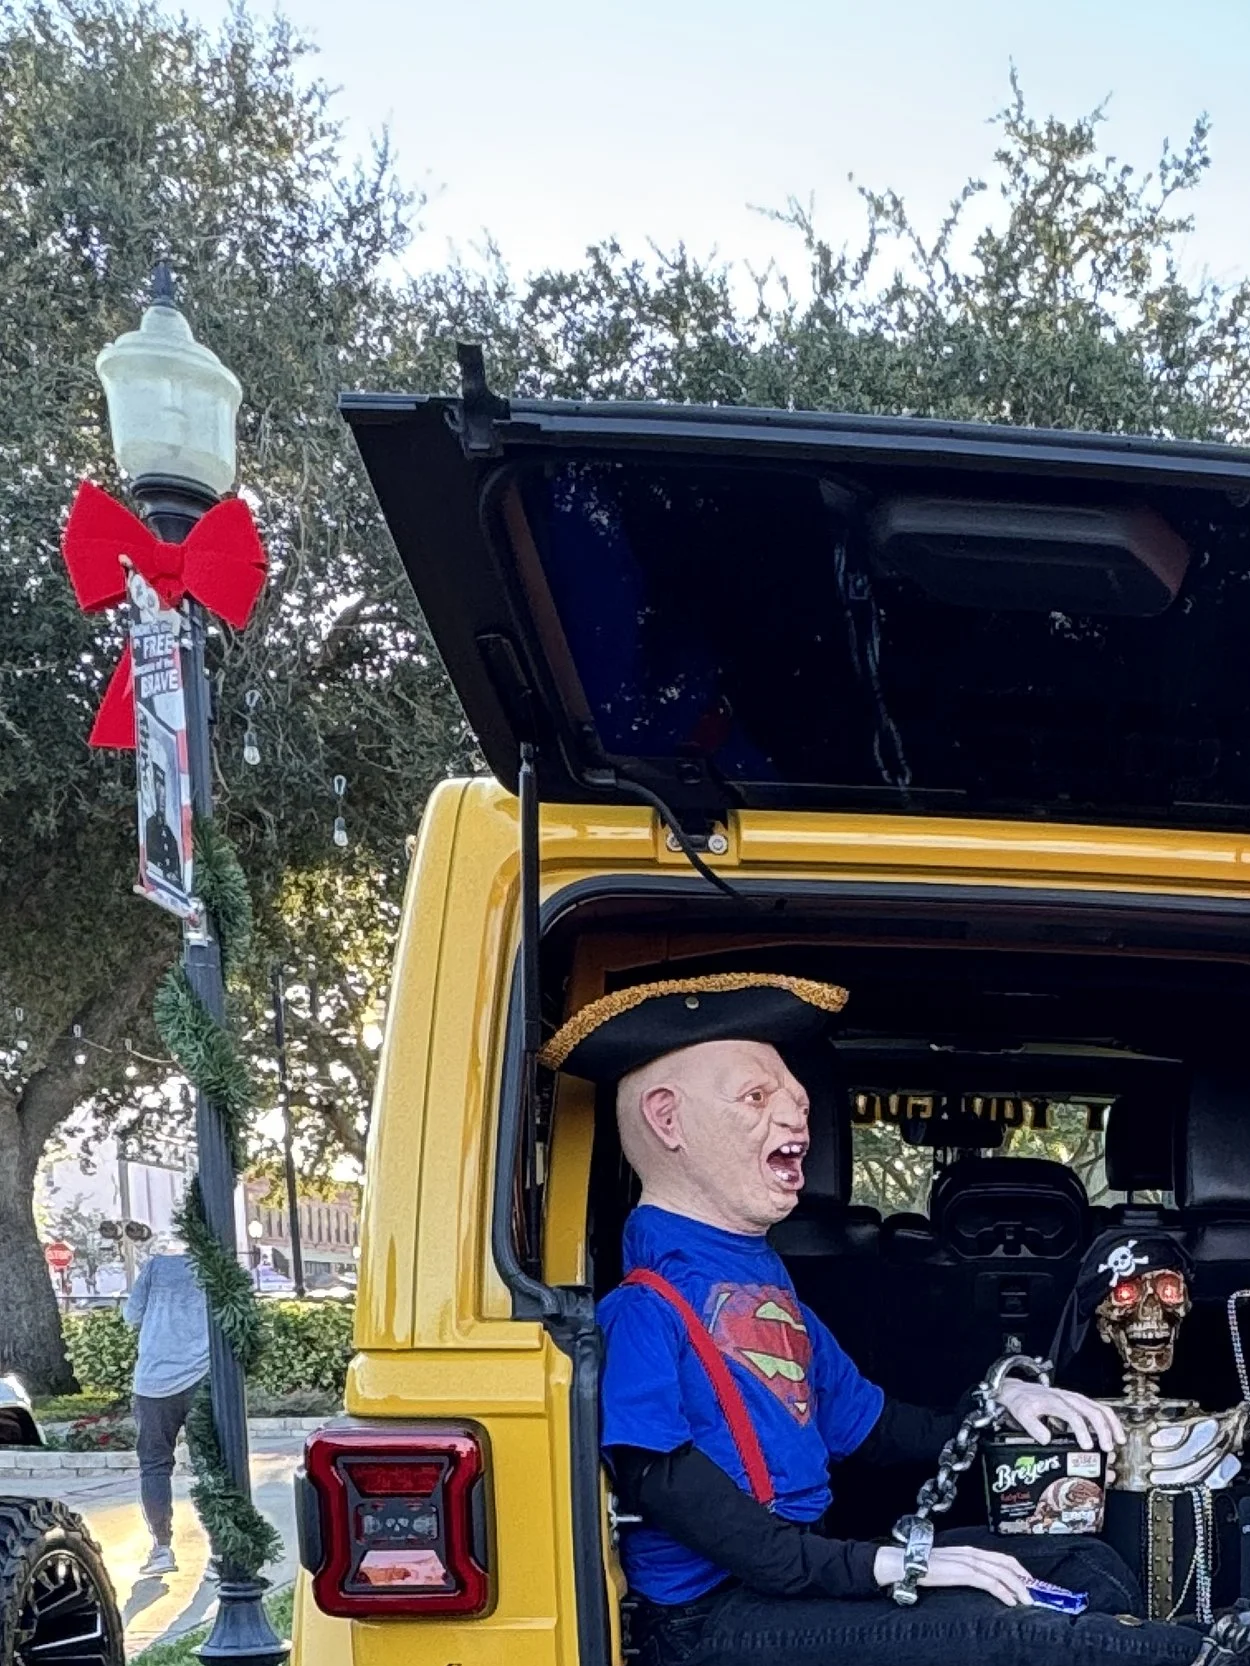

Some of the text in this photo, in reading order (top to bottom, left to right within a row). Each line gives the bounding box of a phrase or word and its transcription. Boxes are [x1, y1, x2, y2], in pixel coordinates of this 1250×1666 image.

[143, 633, 174, 659] FREE
[140, 669, 179, 698] BRAVE
[992, 1455, 1061, 1493] Breyers
